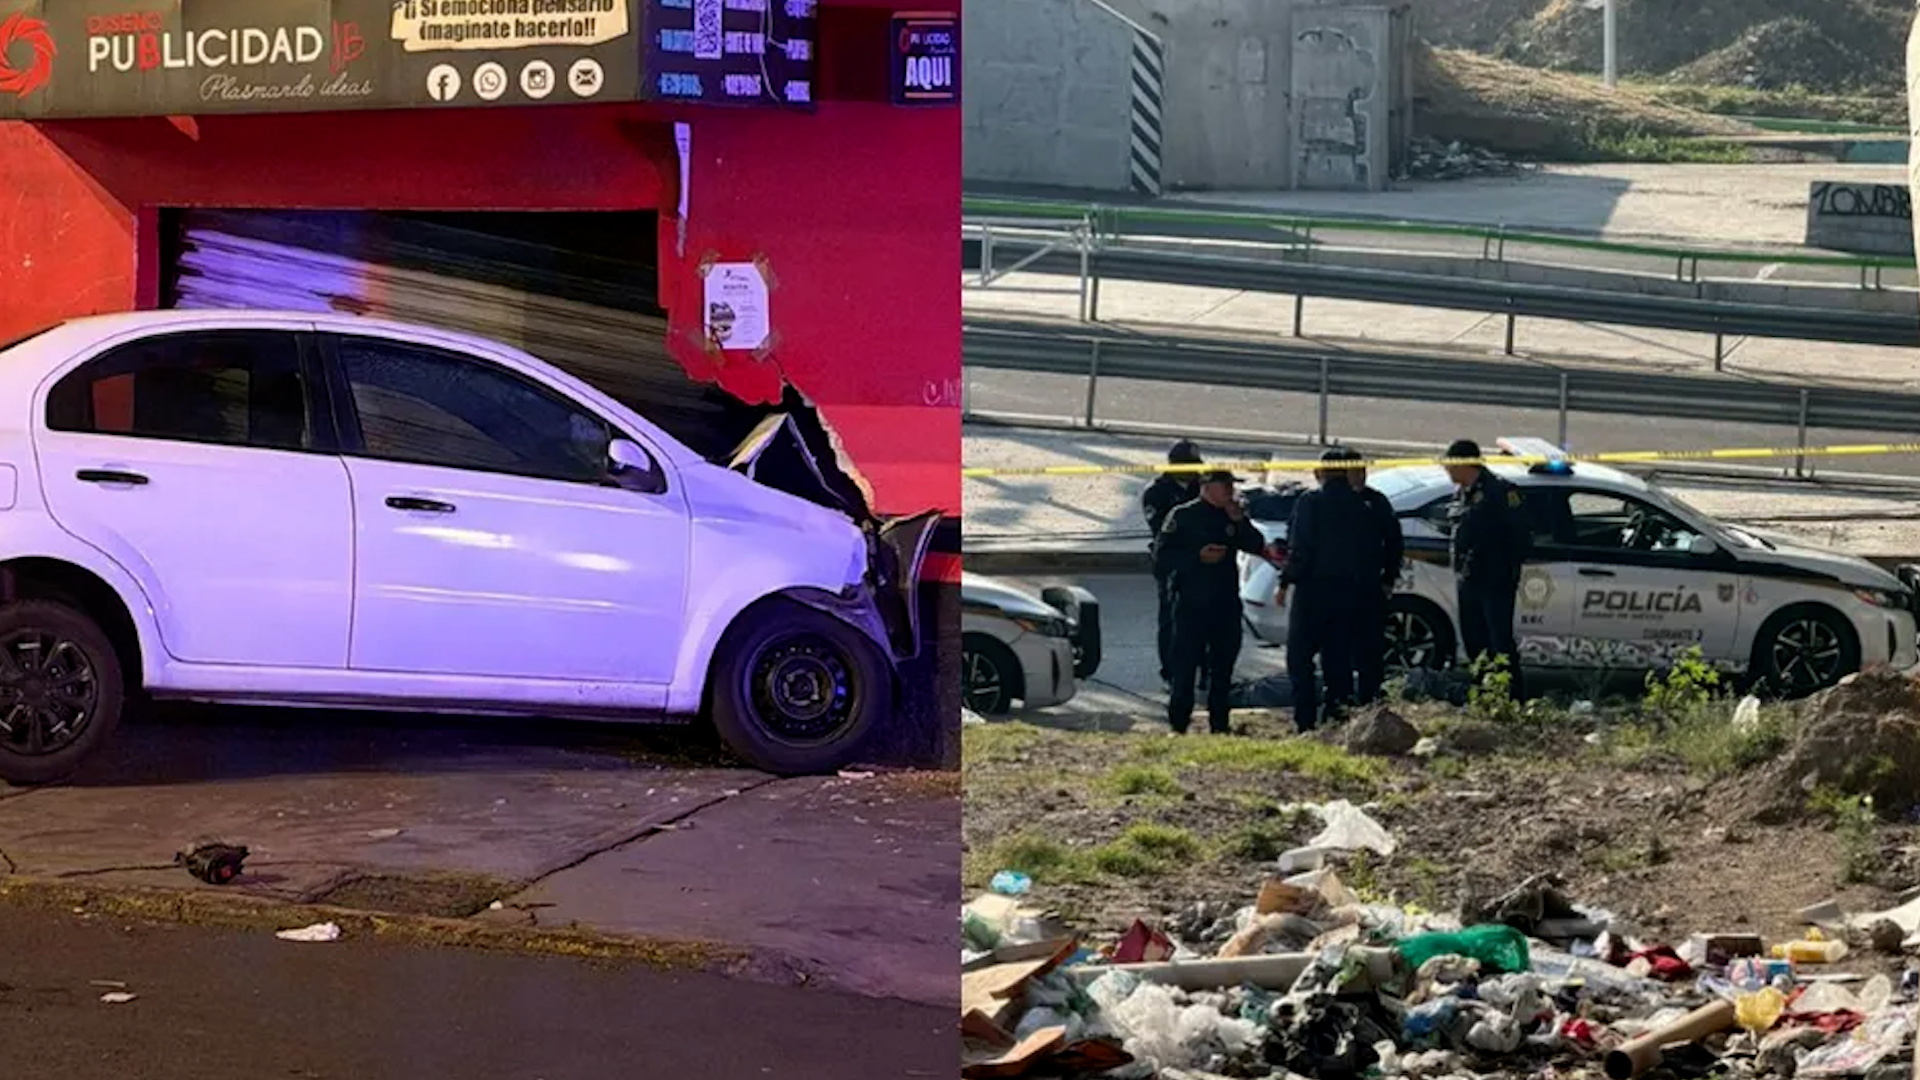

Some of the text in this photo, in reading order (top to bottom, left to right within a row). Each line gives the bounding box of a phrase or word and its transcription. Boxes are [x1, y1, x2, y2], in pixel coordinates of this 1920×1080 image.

[441, 0, 529, 16] emociona
[533, 0, 613, 14] pensarlo
[419, 18, 596, 41] imaginate hacerlo!!
[89, 26, 323, 72] PUBLICIDAD
[201, 73, 372, 100] Plasmando ideas
[905, 56, 951, 90] AQUI
[1582, 585, 1704, 613] POLICÍA
